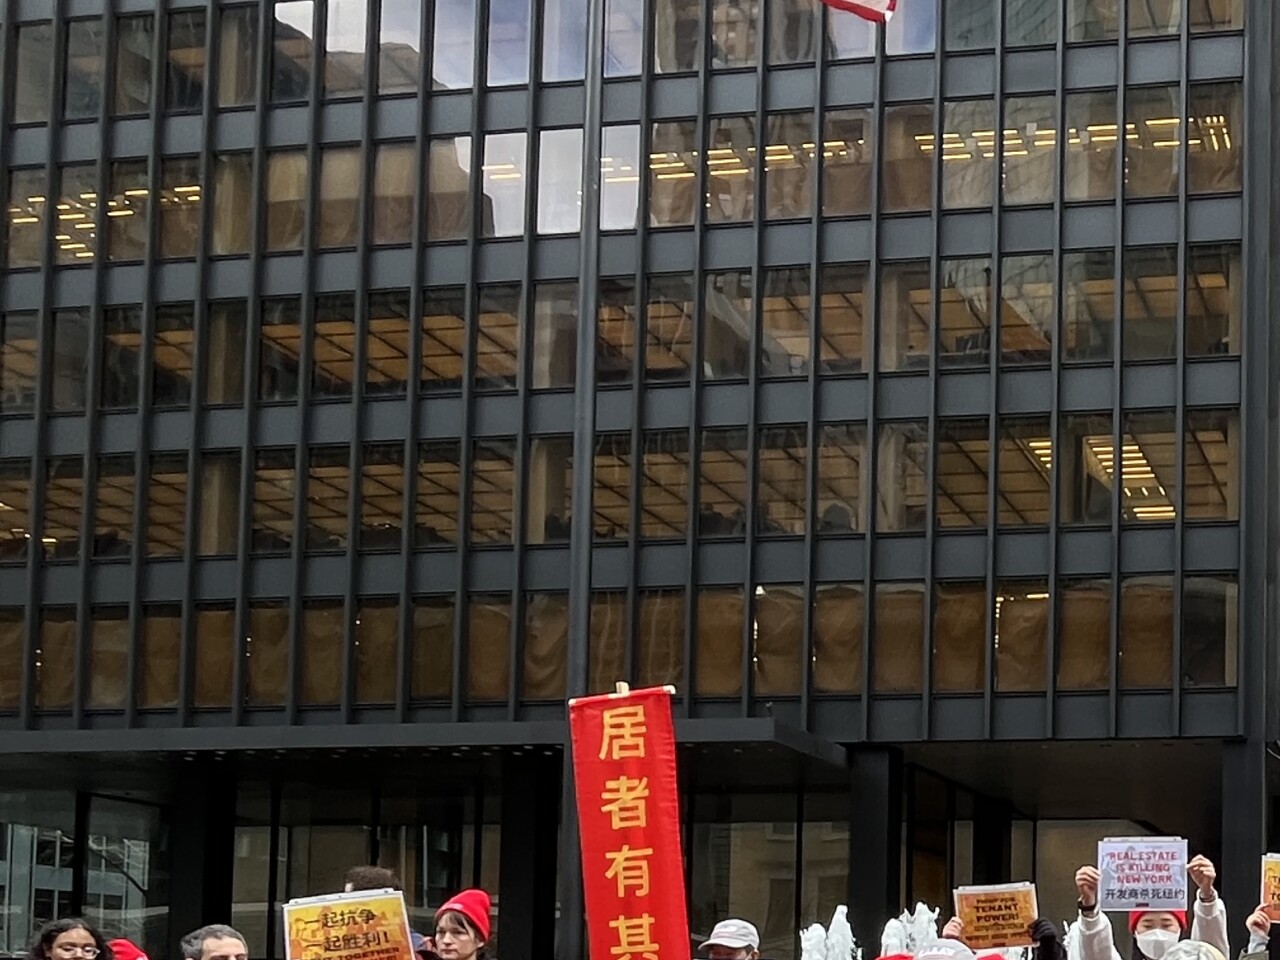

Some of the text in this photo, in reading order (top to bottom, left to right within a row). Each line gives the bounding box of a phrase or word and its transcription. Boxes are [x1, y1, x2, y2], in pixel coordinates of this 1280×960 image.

[1109, 851, 1177, 860] REAL ESTATE
[1116, 863, 1170, 872] IS KILLING
[1117, 875, 1173, 884] NEW YORK
[973, 904, 1019, 913] TENANT
[304, 909, 377, 928] 一起抗争
[976, 913, 1019, 922] POWER!
[337, 947, 400, 960] TOGETHER
